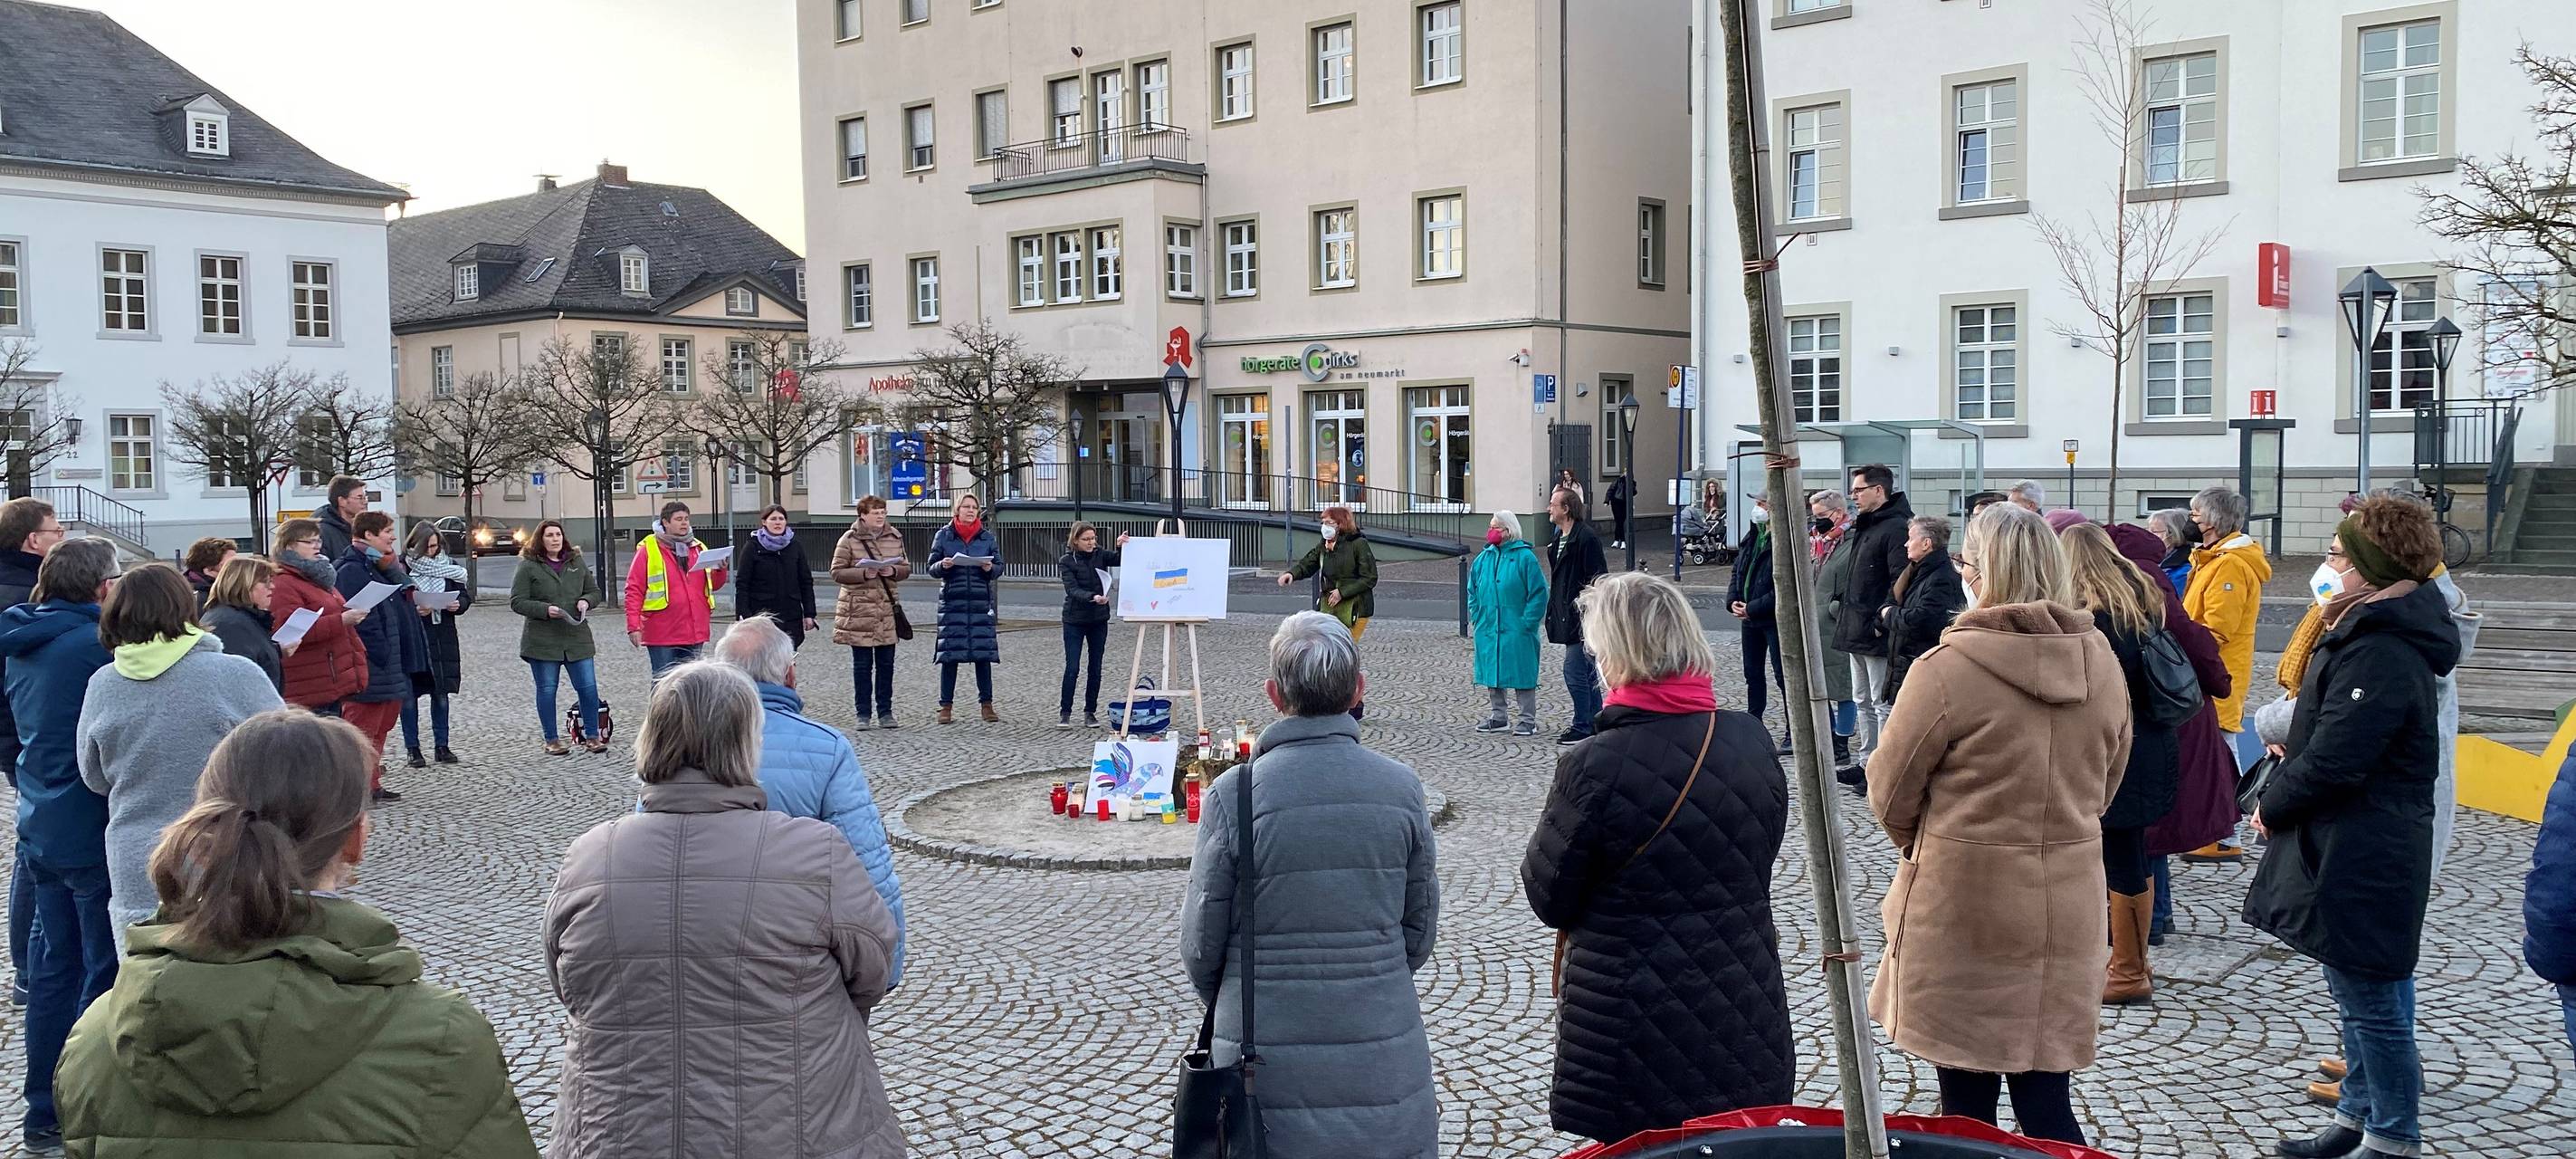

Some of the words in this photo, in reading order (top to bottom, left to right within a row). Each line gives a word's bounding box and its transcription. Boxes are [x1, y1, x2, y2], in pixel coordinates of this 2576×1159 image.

[1358, 369, 1406, 378] neumarkt
[1547, 376, 1554, 390] P
[66, 451, 79, 459] 22
